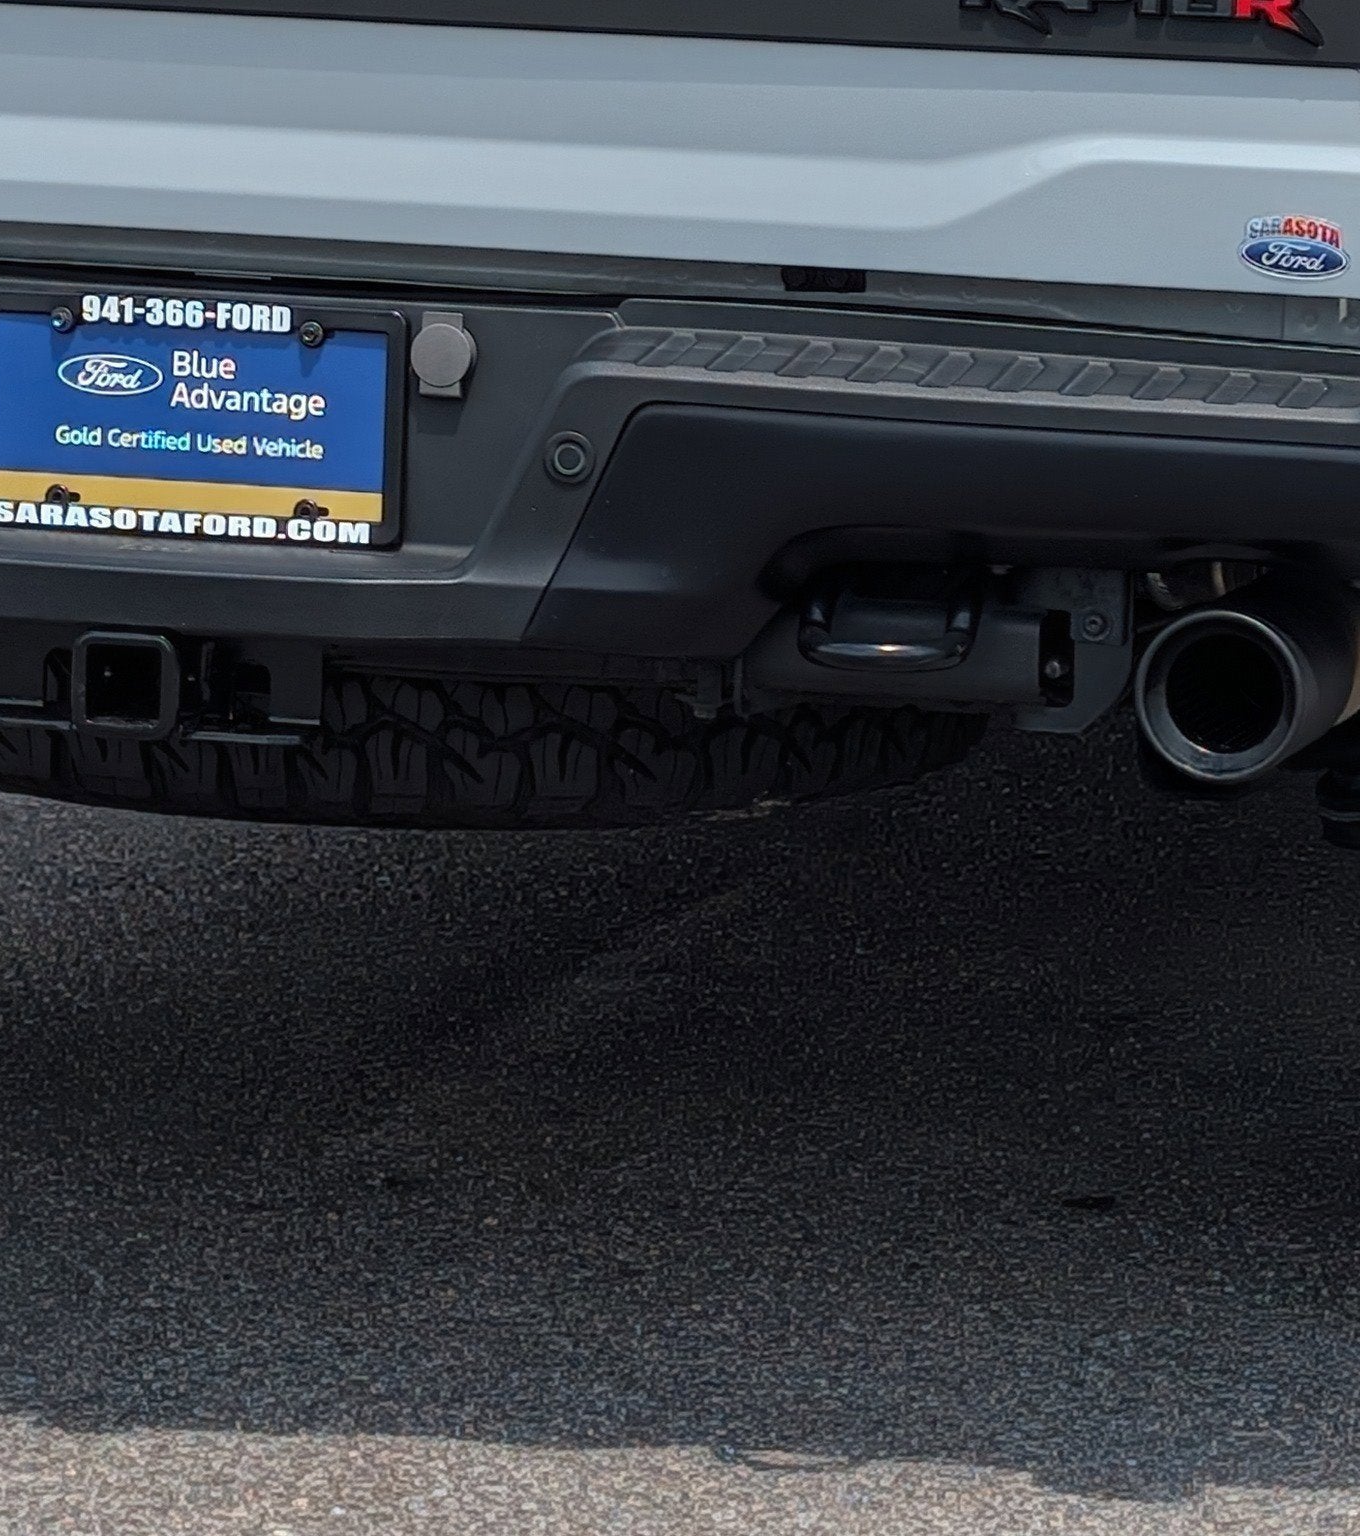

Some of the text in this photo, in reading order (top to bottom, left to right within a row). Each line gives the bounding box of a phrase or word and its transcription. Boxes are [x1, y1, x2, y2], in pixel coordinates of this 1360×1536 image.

[1248, 217, 1341, 249] SARASOTA
[1261, 241, 1327, 271] Ford
[81, 294, 292, 334] 941-366-FORD
[76, 358, 143, 390] Ford
[172, 350, 238, 380] Blue
[169, 381, 327, 421] Advantage
[55, 425, 325, 460] Gold Certified Used Vehicle
